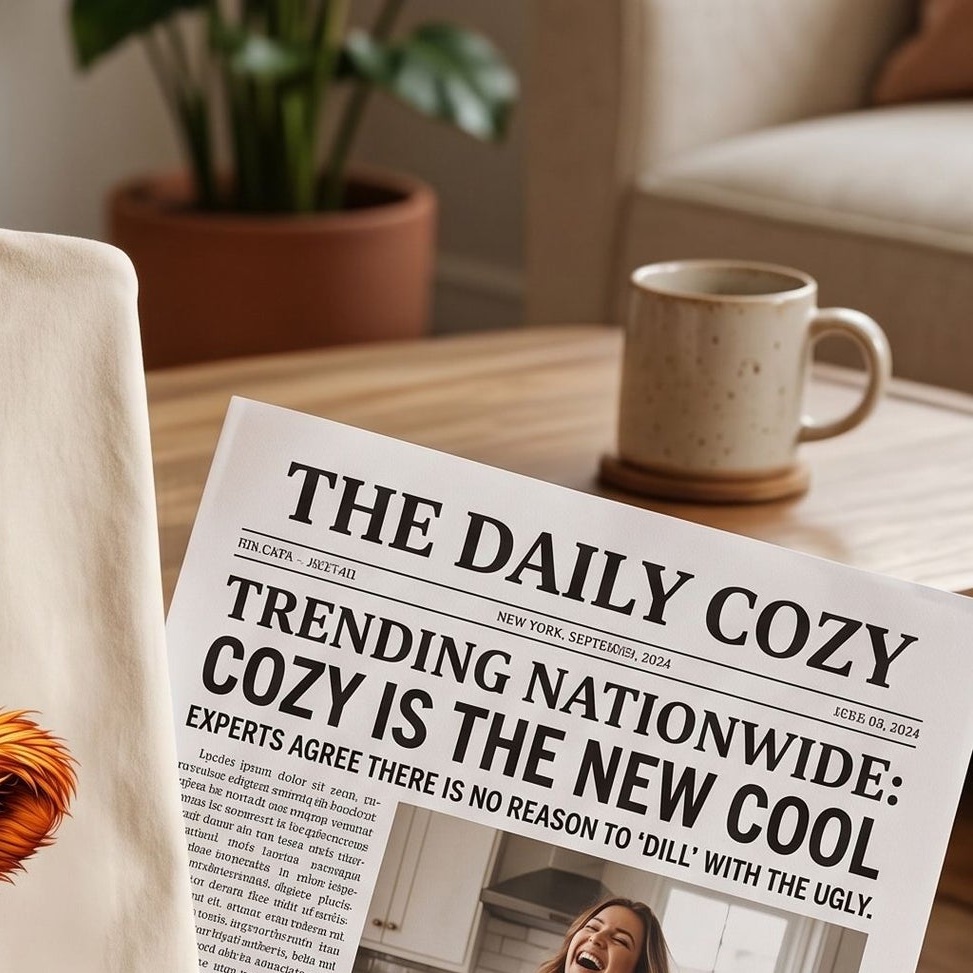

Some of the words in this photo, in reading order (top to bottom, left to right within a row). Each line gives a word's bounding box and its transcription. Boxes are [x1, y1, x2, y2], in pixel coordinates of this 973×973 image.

[286, 460, 443, 558] THE
[453, 510, 695, 626] DAILY
[705, 586, 919, 689] COZY
[496, 610, 526, 628] NEW
[640, 651, 671, 669] 2024
[201, 635, 366, 728] COZY
[370, 680, 433, 750] IS
[450, 700, 567, 789] THE
[572, 738, 719, 829] NEW
[726, 783, 879, 880] COOL
[226, 574, 513, 696] TRENDING
[518, 660, 902, 806] NATIONWIDE:
[276, 770, 307, 790] dolor
[309, 781, 326, 795] sit
[888, 721, 920, 739] 2024
[185, 703, 287, 751] EXPERTS
[285, 734, 364, 776] AGREE
[364, 754, 439, 796] THERE
[439, 776, 467, 802] IS
[466, 784, 507, 813] NO
[505, 793, 600, 841] REASON
[602, 821, 634, 849] TO
[703, 846, 762, 887] WITH
[762, 866, 812, 901] THE
[809, 879, 873, 919] UGLY.
